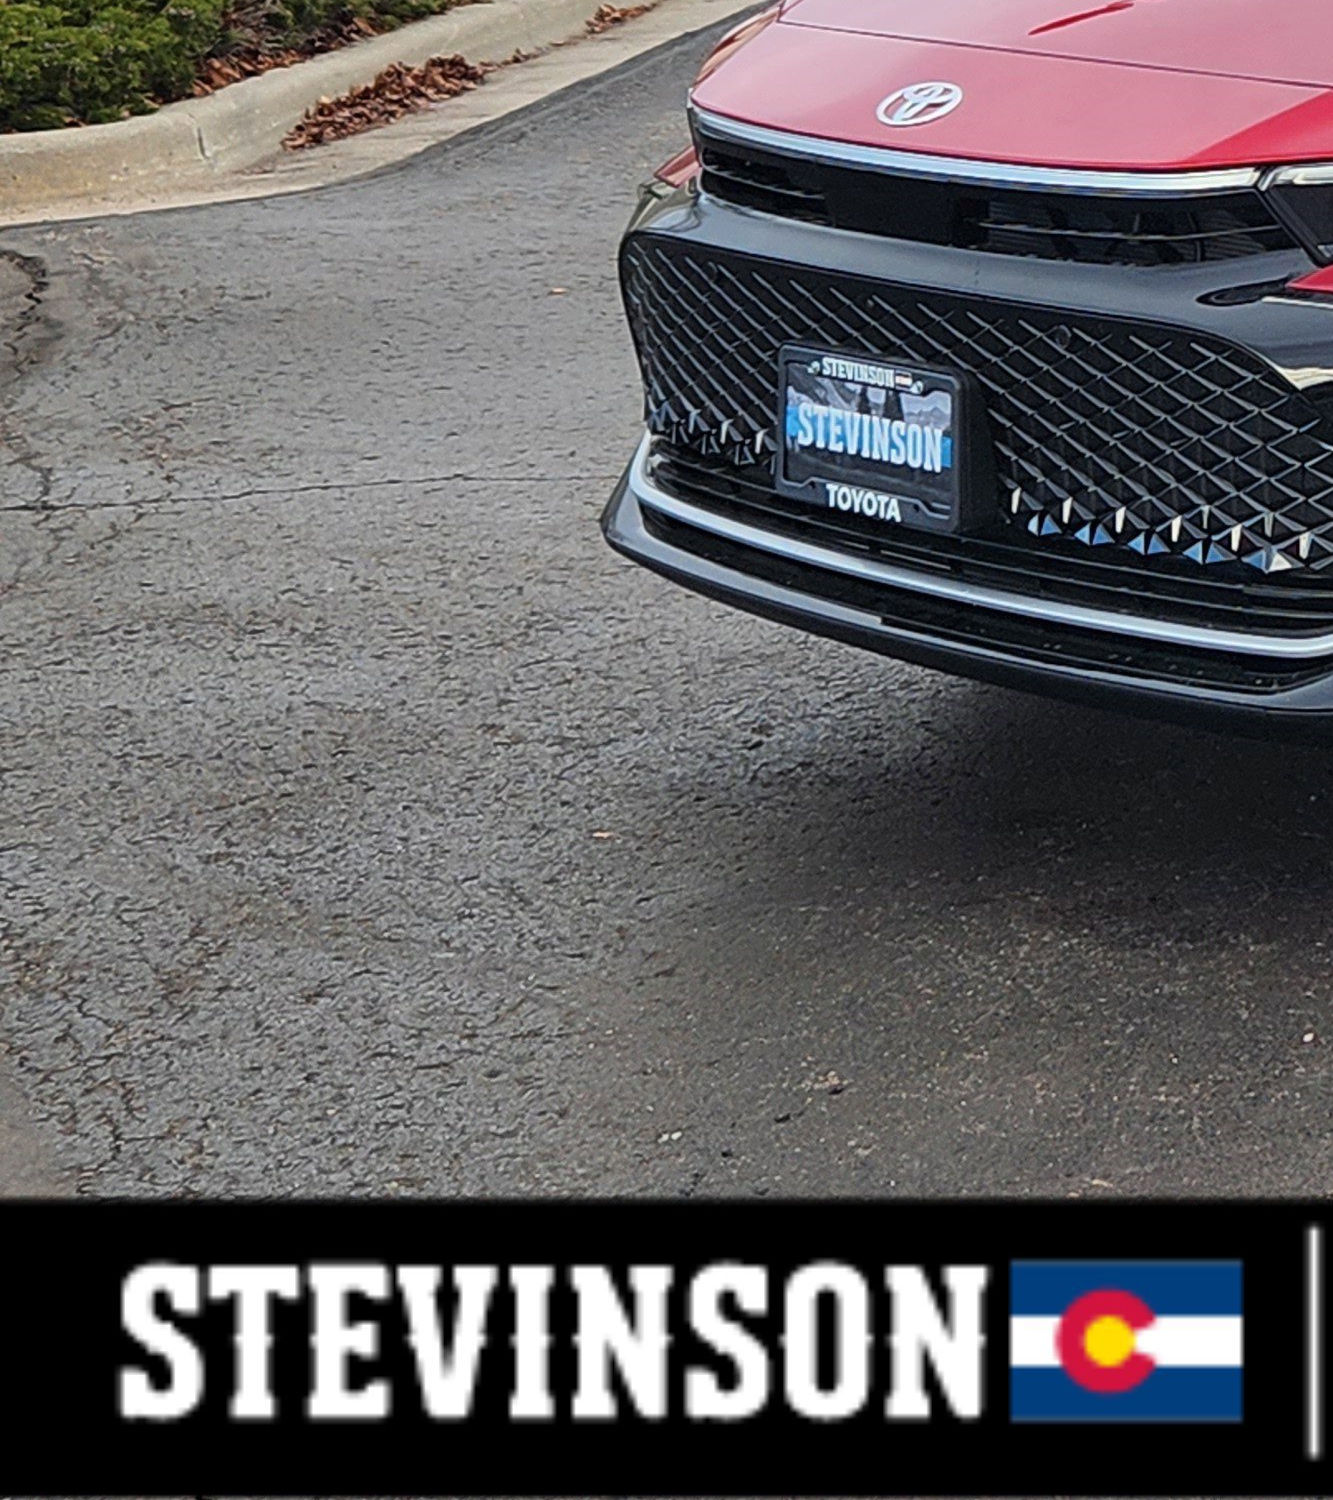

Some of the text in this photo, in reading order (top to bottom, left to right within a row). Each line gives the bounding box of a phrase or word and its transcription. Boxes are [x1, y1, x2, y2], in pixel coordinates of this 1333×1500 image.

[821, 356, 896, 388] STEVINSON
[796, 400, 943, 474] STEVINSON
[825, 482, 902, 523] TOYOTA
